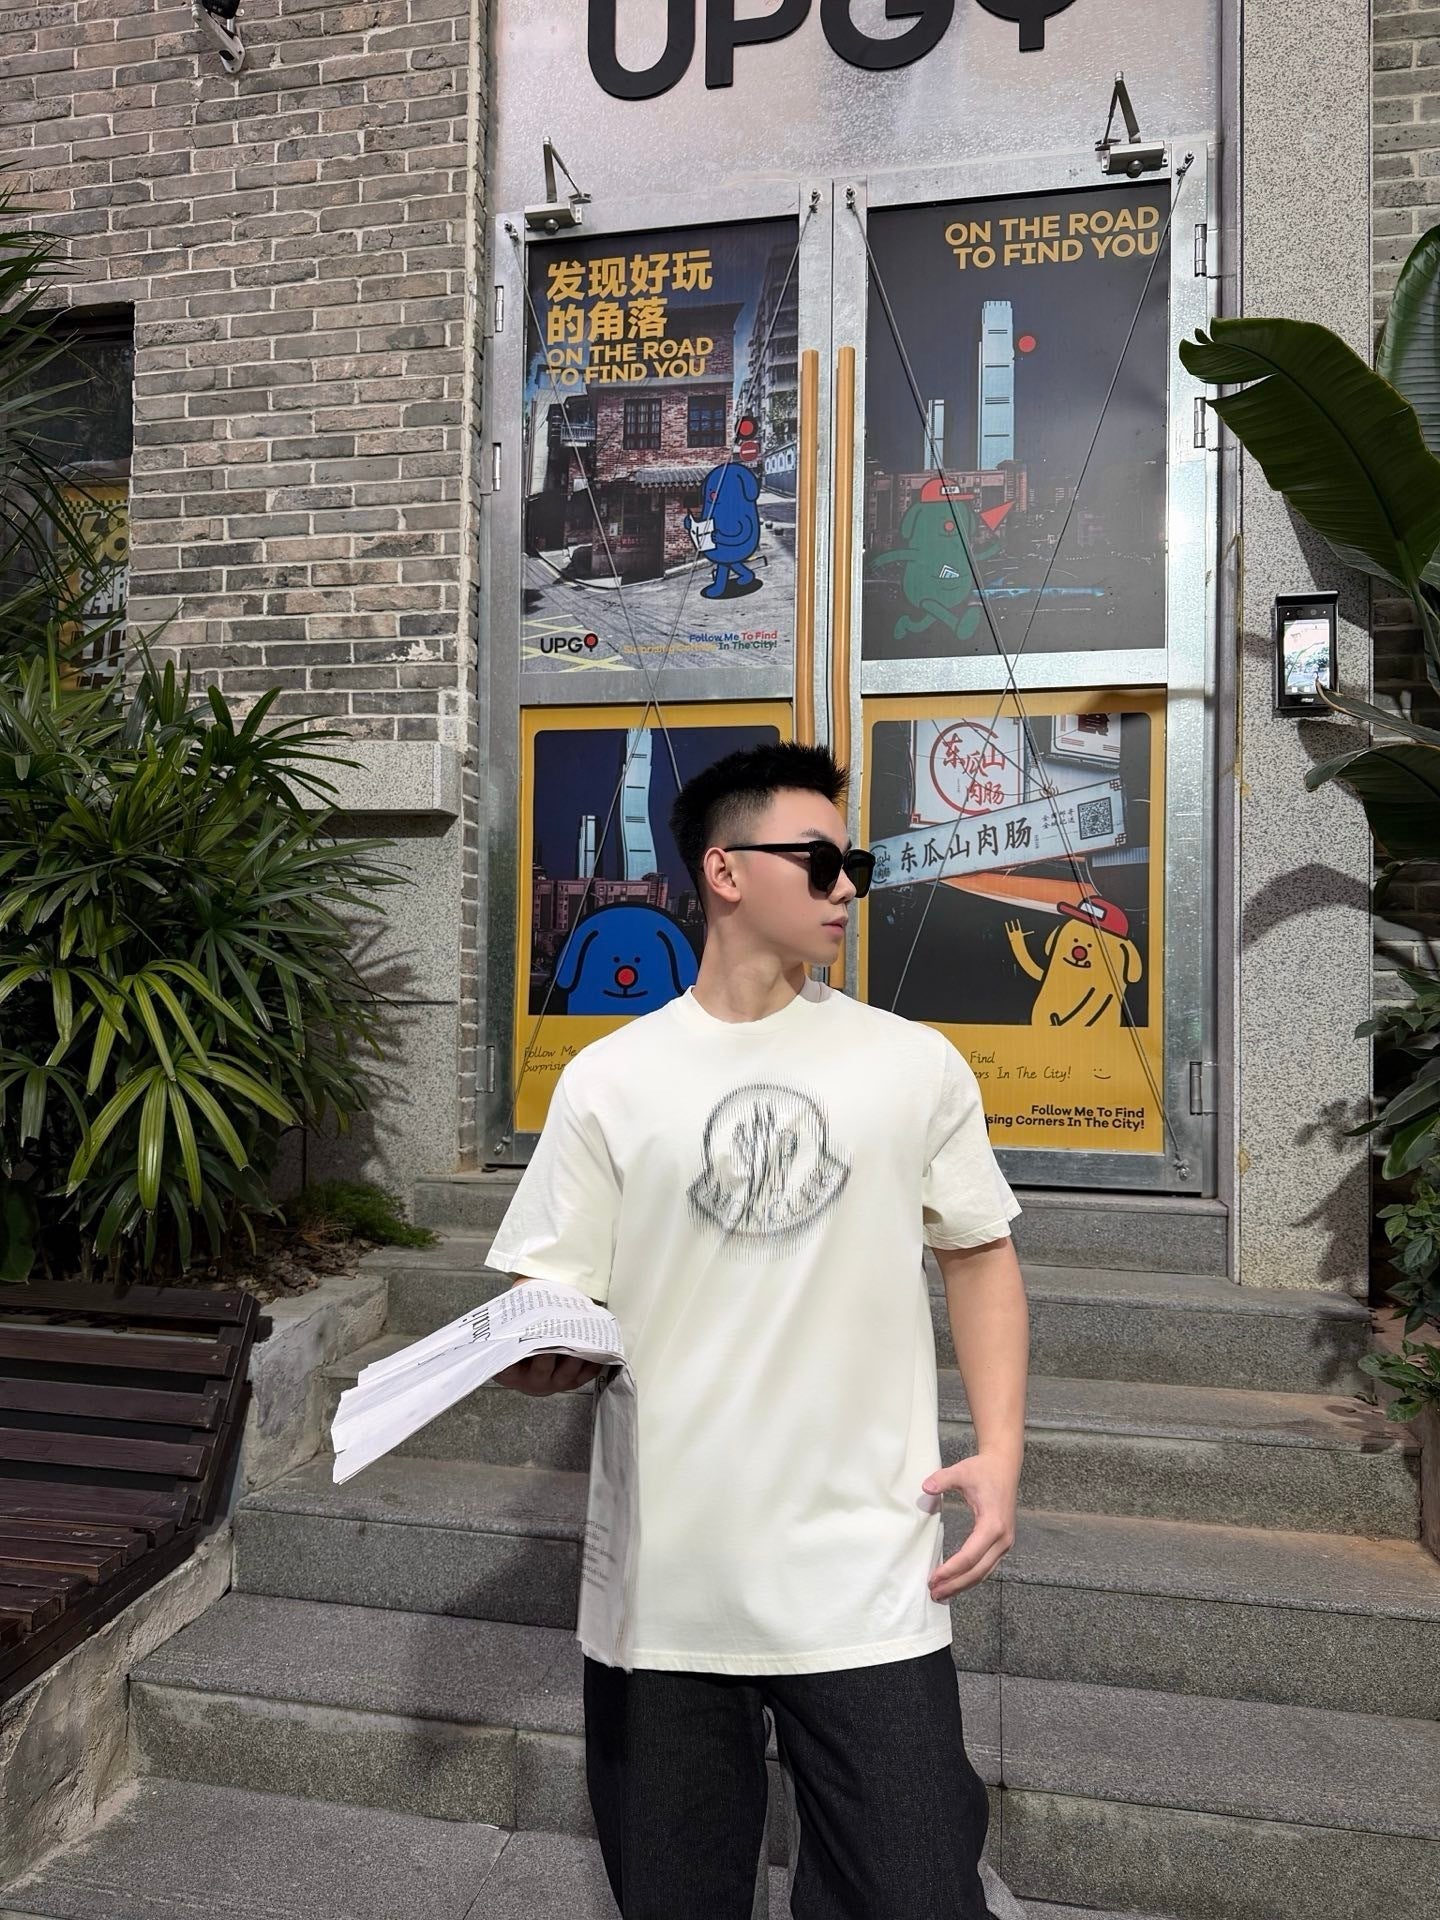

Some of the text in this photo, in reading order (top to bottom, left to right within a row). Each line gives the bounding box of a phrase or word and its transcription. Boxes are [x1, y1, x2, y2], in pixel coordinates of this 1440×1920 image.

[944, 206, 1160, 246] ON THE ROAD
[952, 231, 1159, 270] TO FIND YOU
[546, 249, 713, 303] 发现好玩
[546, 296, 668, 346] 的角落
[547, 337, 714, 368] ON THE ROAD
[546, 357, 706, 386] TO FIND YOU
[689, 630, 778, 643] Follow Me To Find
[718, 641, 729, 651] In
[732, 640, 750, 650] The
[752, 639, 778, 651] City!
[900, 817, 1032, 873] 东瓜山肉肠
[524, 1045, 578, 1058] Follow Me
[969, 1051, 996, 1064] Find
[997, 1066, 1010, 1080] In
[1016, 1066, 1037, 1080] The
[1043, 1066, 1072, 1083] City!
[1031, 1104, 1145, 1118] Follow Me To Find
[1015, 1115, 1065, 1127] Corners
[1067, 1116, 1082, 1127] In
[1084, 1117, 1109, 1128] The
[1111, 1117, 1145, 1132] City!
